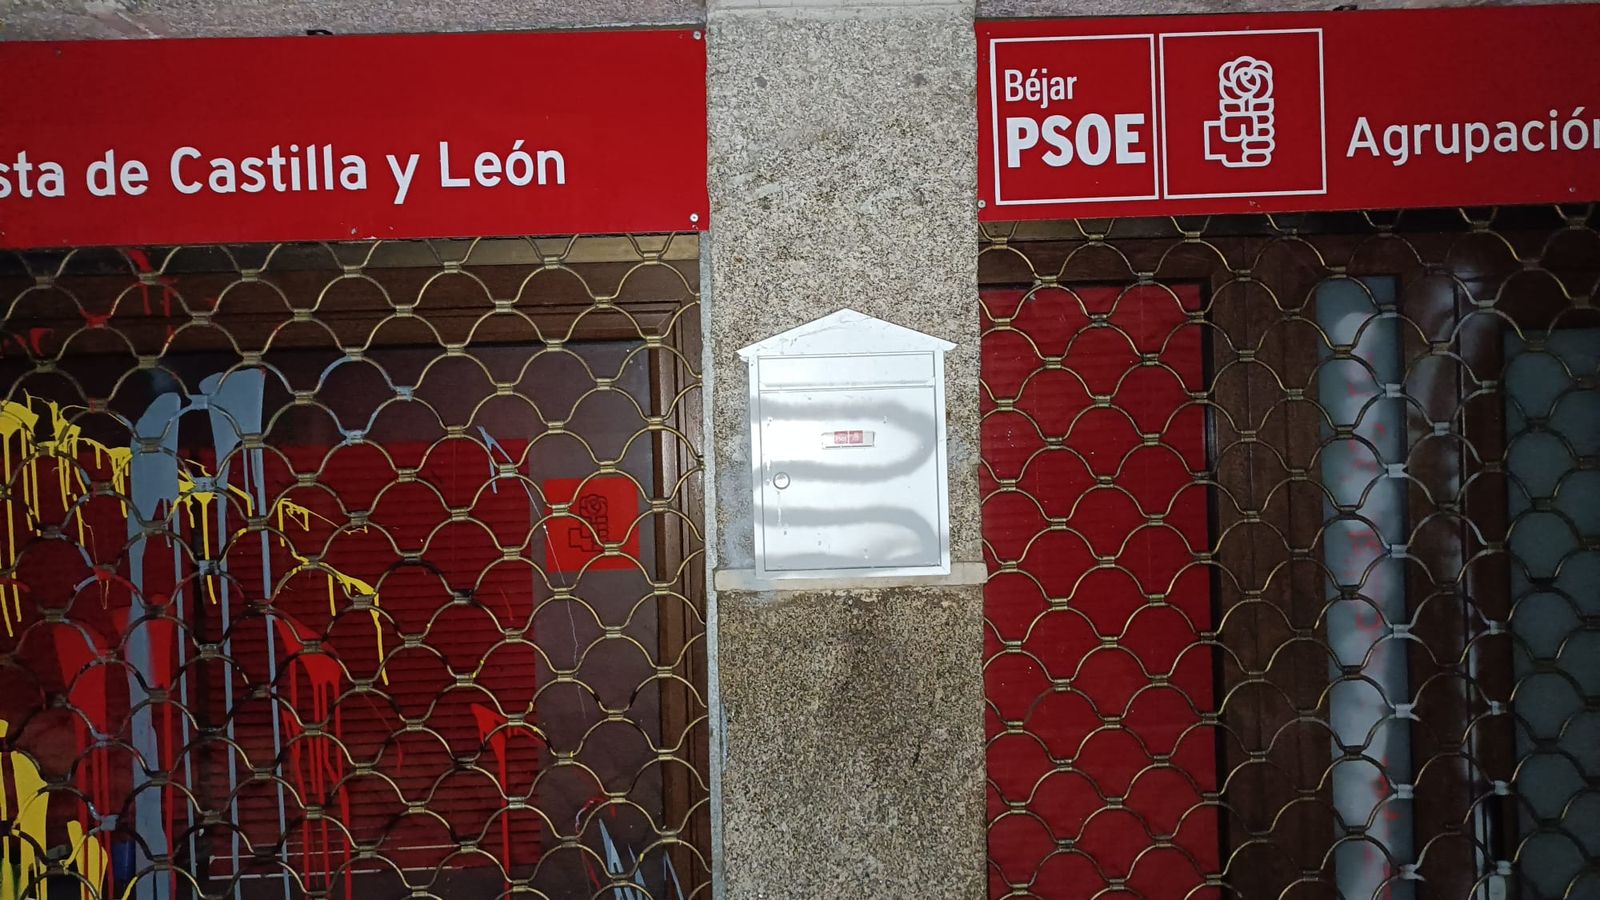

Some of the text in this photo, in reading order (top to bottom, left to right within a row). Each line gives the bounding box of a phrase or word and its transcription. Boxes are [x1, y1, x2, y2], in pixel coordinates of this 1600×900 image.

[1004, 68, 1078, 109] Béjar
[1005, 112, 1147, 169] PSOE
[1346, 106, 1600, 167] Agrupació
[86, 148, 149, 197] de
[170, 143, 368, 194] Castilla
[385, 153, 420, 205] y
[439, 139, 566, 189] León
